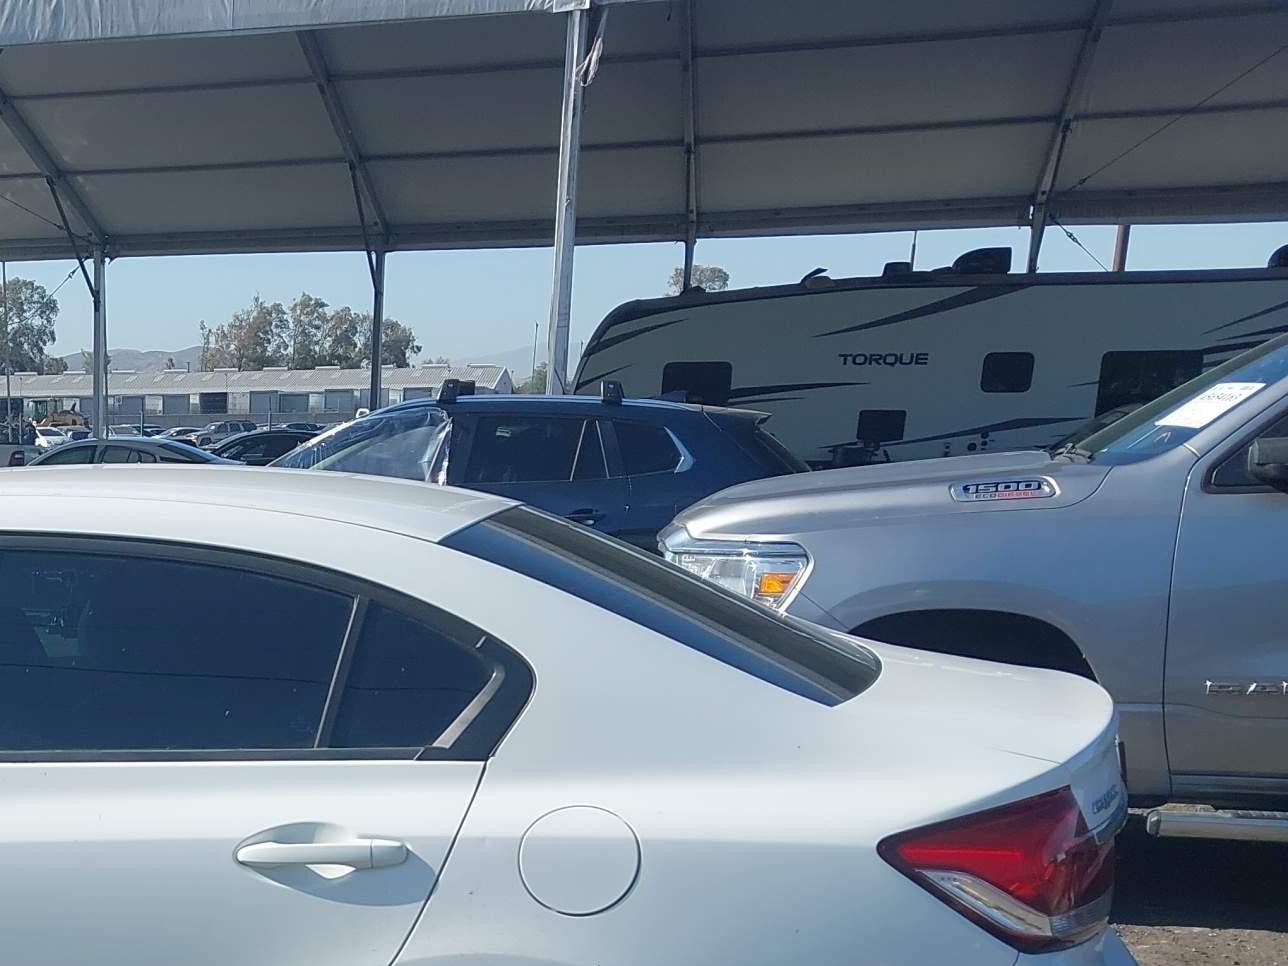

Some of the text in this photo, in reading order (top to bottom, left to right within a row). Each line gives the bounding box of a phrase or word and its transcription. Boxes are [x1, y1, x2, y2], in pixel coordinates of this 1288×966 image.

[838, 353, 929, 367] TORQUE
[964, 481, 1041, 493] 1500
[1204, 680, 1288, 696] RA
